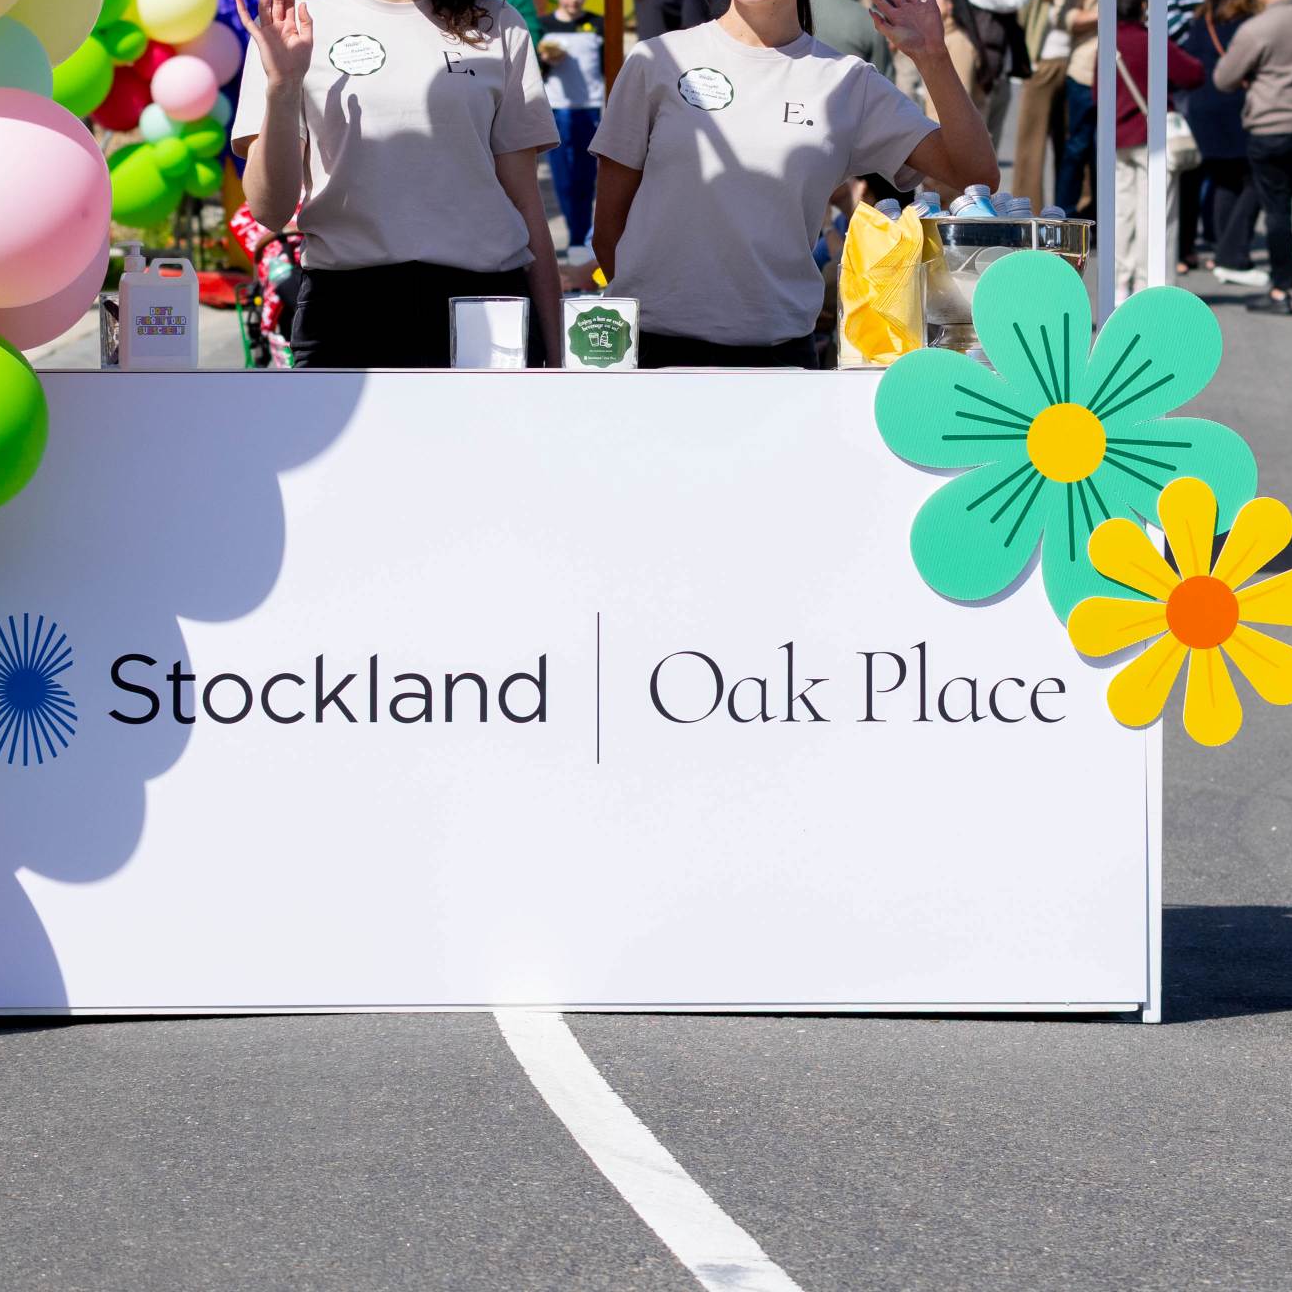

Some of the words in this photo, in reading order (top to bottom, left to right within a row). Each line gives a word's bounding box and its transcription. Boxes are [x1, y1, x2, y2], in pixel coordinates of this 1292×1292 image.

[443, 51, 476, 77] E.
[783, 102, 814, 127] E.
[109, 653, 548, 725] Stockland
[649, 641, 831, 724] Oak
[856, 641, 1067, 724] Place
